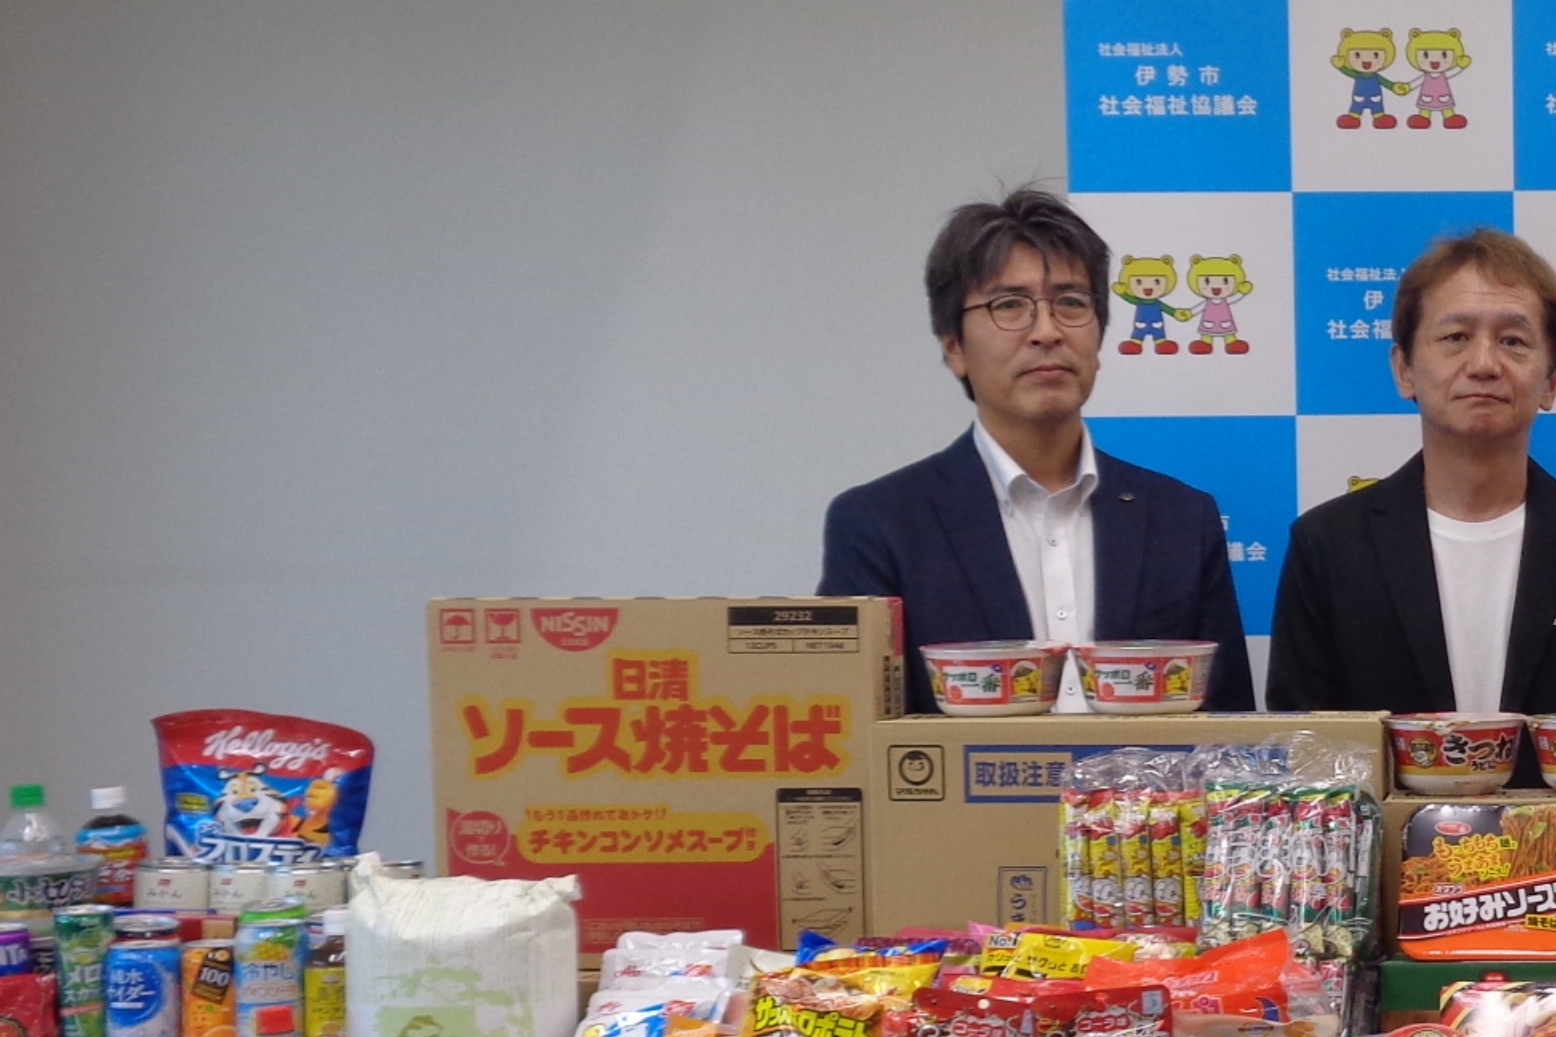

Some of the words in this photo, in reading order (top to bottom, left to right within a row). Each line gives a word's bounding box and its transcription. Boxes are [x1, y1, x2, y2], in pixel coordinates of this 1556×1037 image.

[1098, 42, 1183, 56] 社会福祉法人
[1135, 64, 1220, 86] 伊勢市
[1099, 93, 1258, 117] 社会福祉協議会
[1326, 266, 1405, 281] 社会福祉法
[541, 612, 610, 637] NISSIN
[612, 657, 688, 700] 日清
[202, 726, 331, 770] Kellogg's
[464, 704, 841, 775] ソース焼そば
[1443, 735, 1515, 763] きつね
[975, 761, 1066, 788] 取扱注意
[528, 829, 746, 855] チキンコンソメスープ
[198, 968, 229, 986] 100
